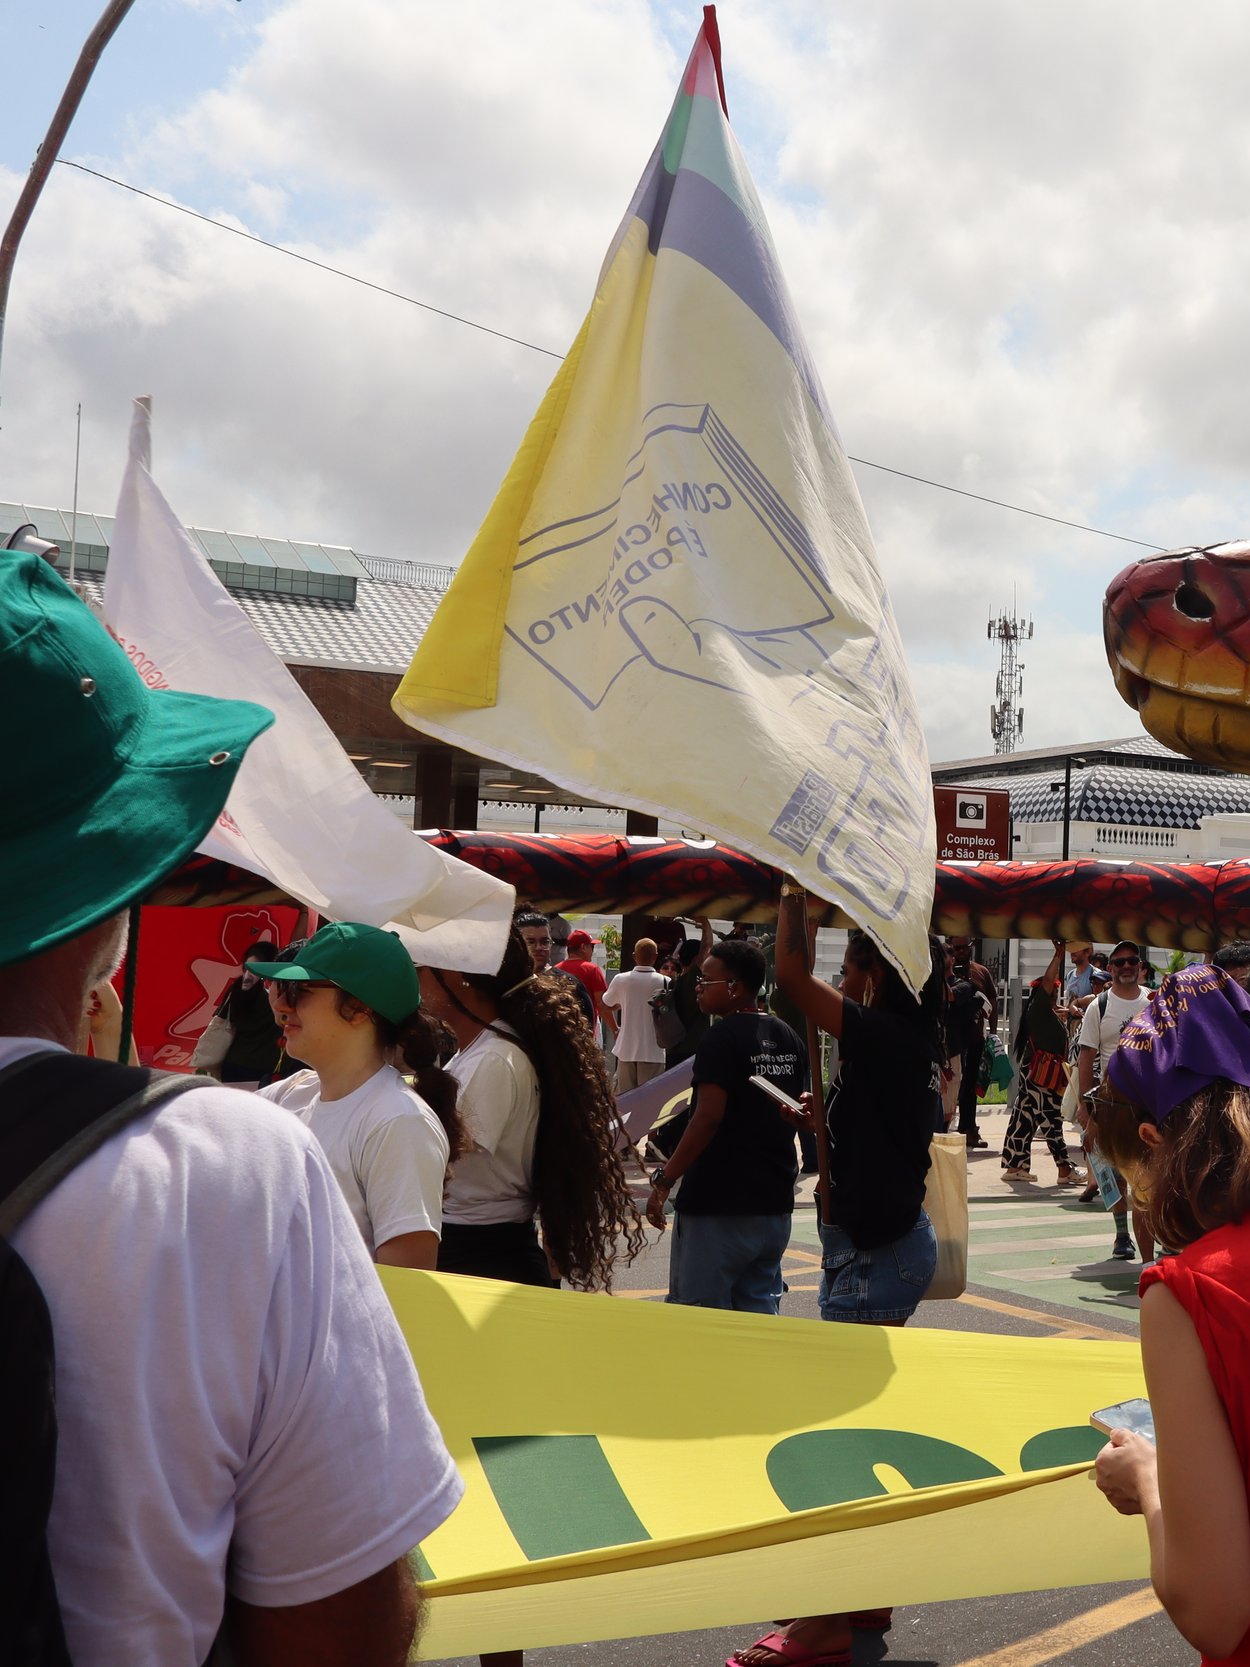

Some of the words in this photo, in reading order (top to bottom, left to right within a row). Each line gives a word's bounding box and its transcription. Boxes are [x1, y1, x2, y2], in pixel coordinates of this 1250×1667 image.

[946, 833, 996, 847] Complexo
[941, 847, 953, 858] de
[956, 848, 975, 859] São
[977, 849, 1000, 861] Brás
